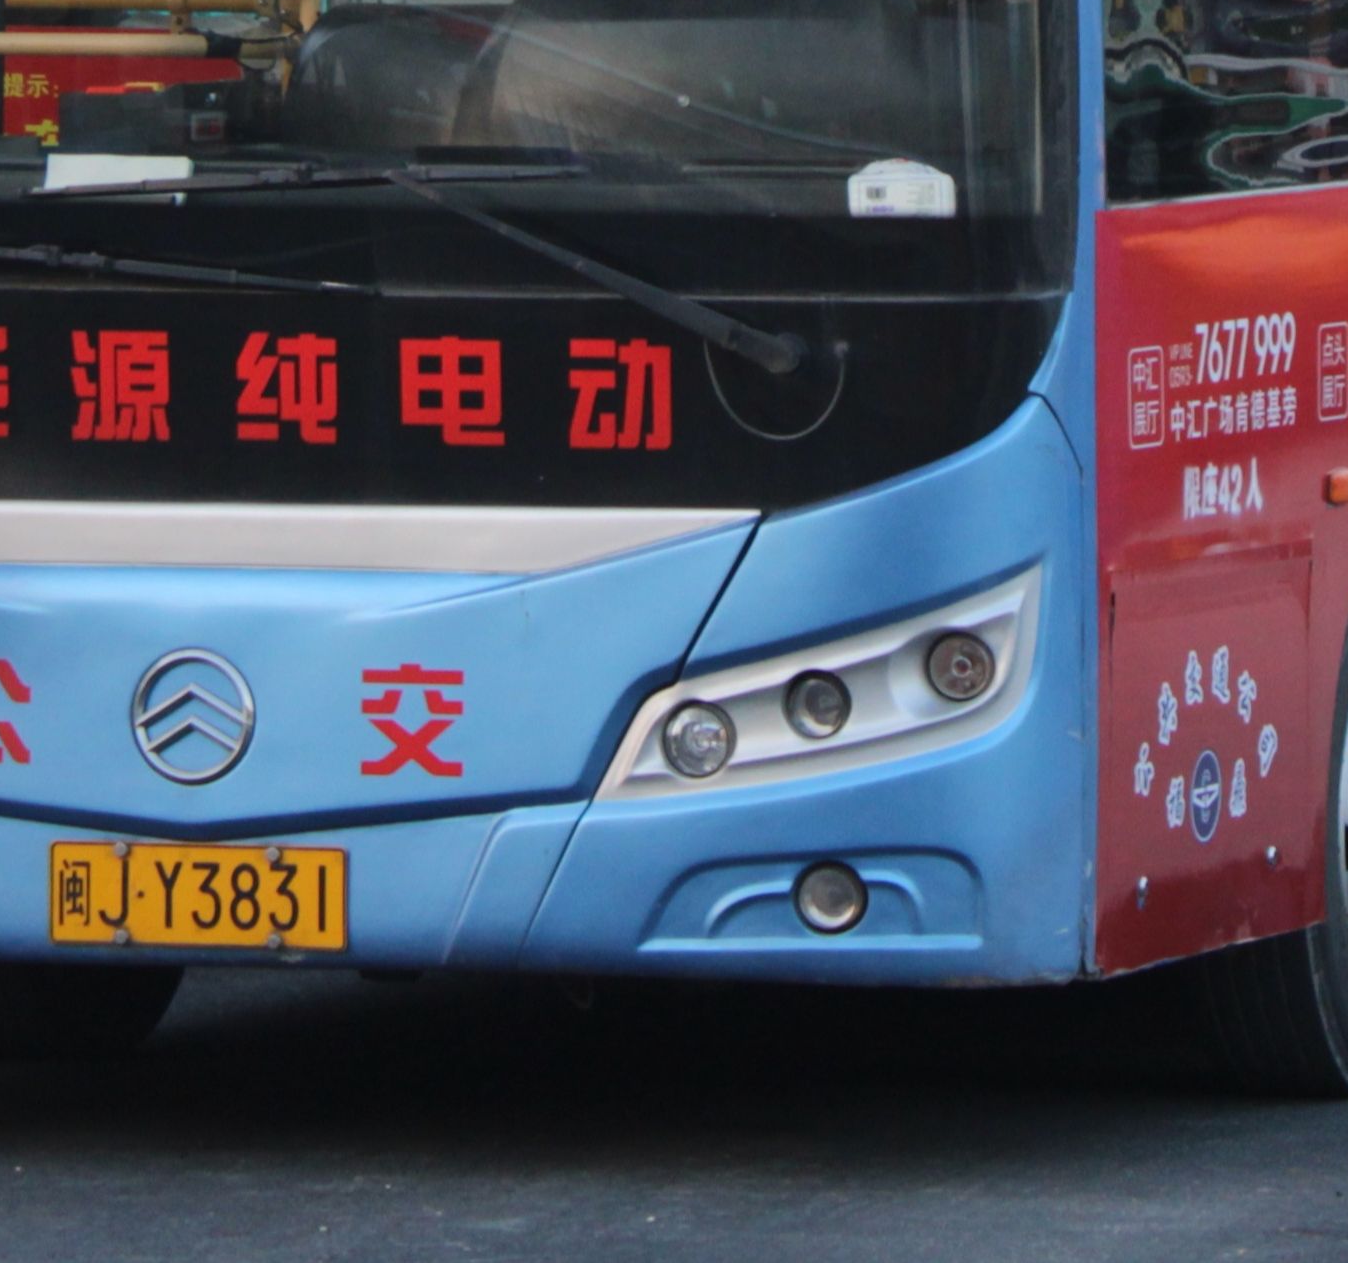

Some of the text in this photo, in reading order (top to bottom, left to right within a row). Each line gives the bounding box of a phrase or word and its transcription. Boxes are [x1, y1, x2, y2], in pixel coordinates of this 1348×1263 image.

[1195, 311, 1297, 385] 7677 999
[1321, 331, 1346, 368] 点头
[1132, 356, 1160, 393] 中汇
[1132, 399, 1161, 437] 展厅
[1170, 386, 1298, 443] 中汇广场肯德基旁
[58, 859, 327, 932] 闽J·Y3831
